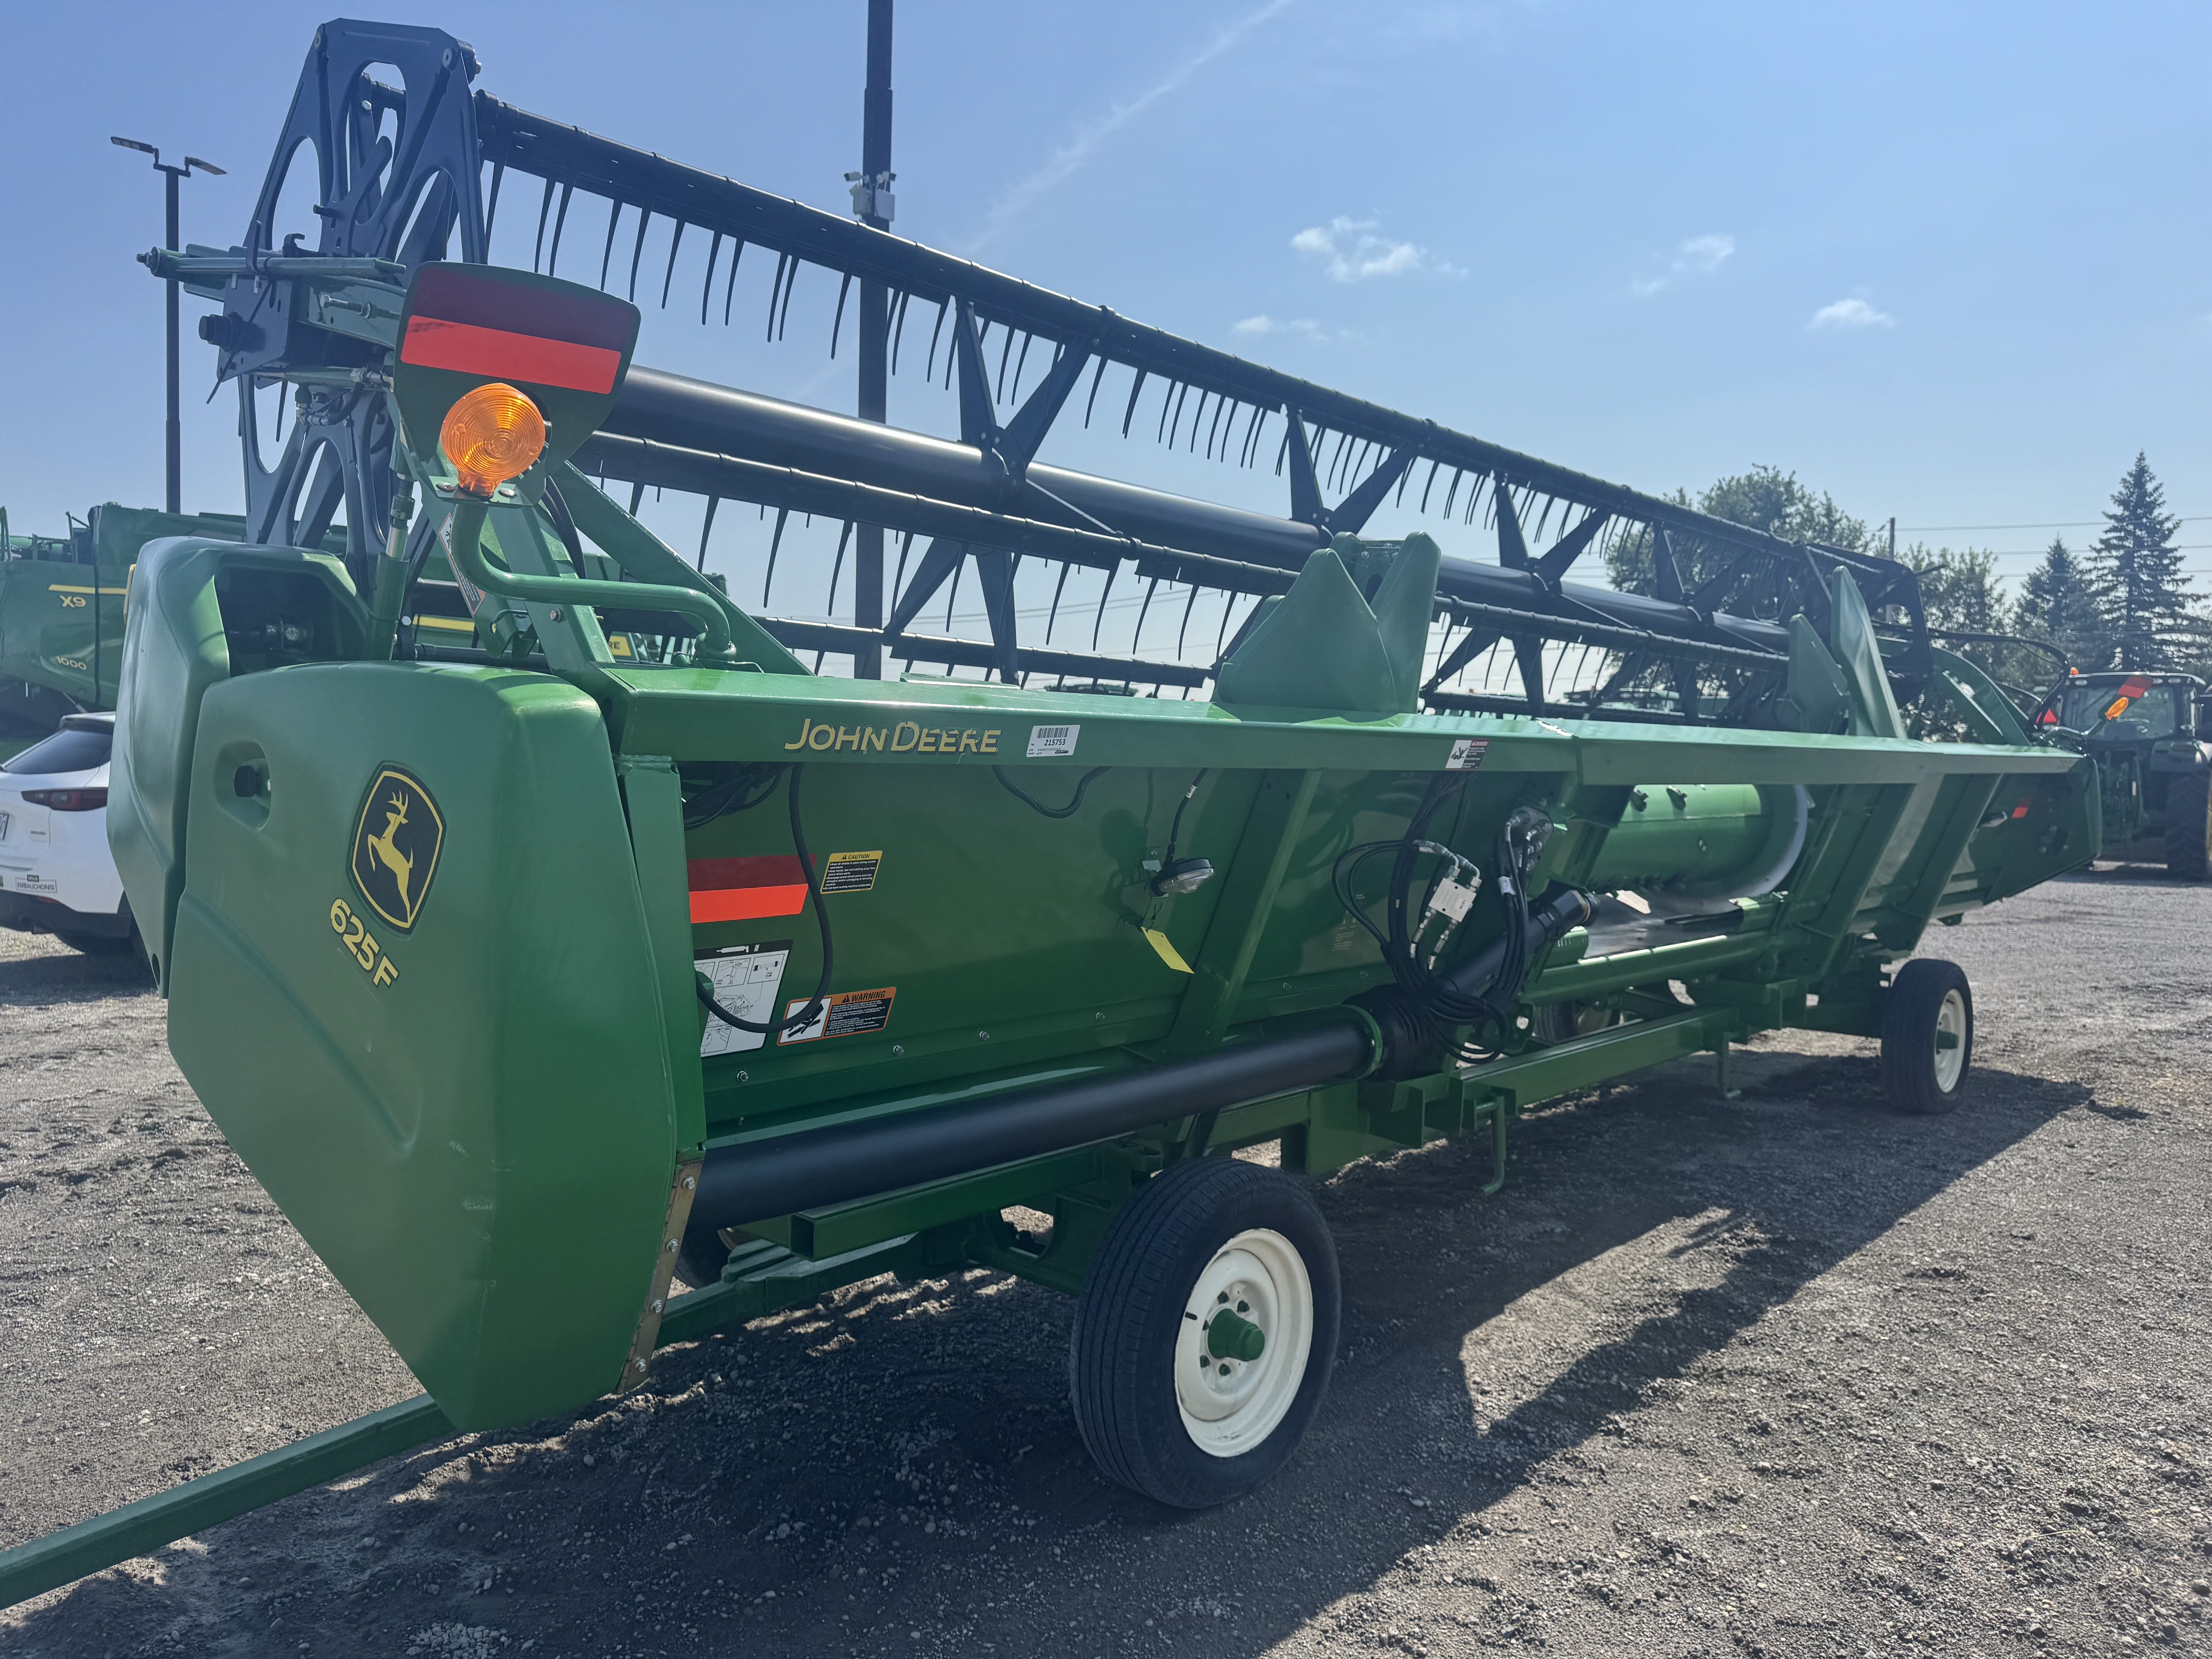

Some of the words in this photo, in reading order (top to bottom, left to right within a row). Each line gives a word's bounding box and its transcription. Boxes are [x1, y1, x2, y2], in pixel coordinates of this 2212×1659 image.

[59, 594, 86, 608] X9
[56, 656, 87, 670] 1000
[785, 718, 888, 750] JOHN
[891, 721, 1001, 752] DEERE
[330, 898, 399, 986] 625F
[852, 991, 886, 1001] WARNING
